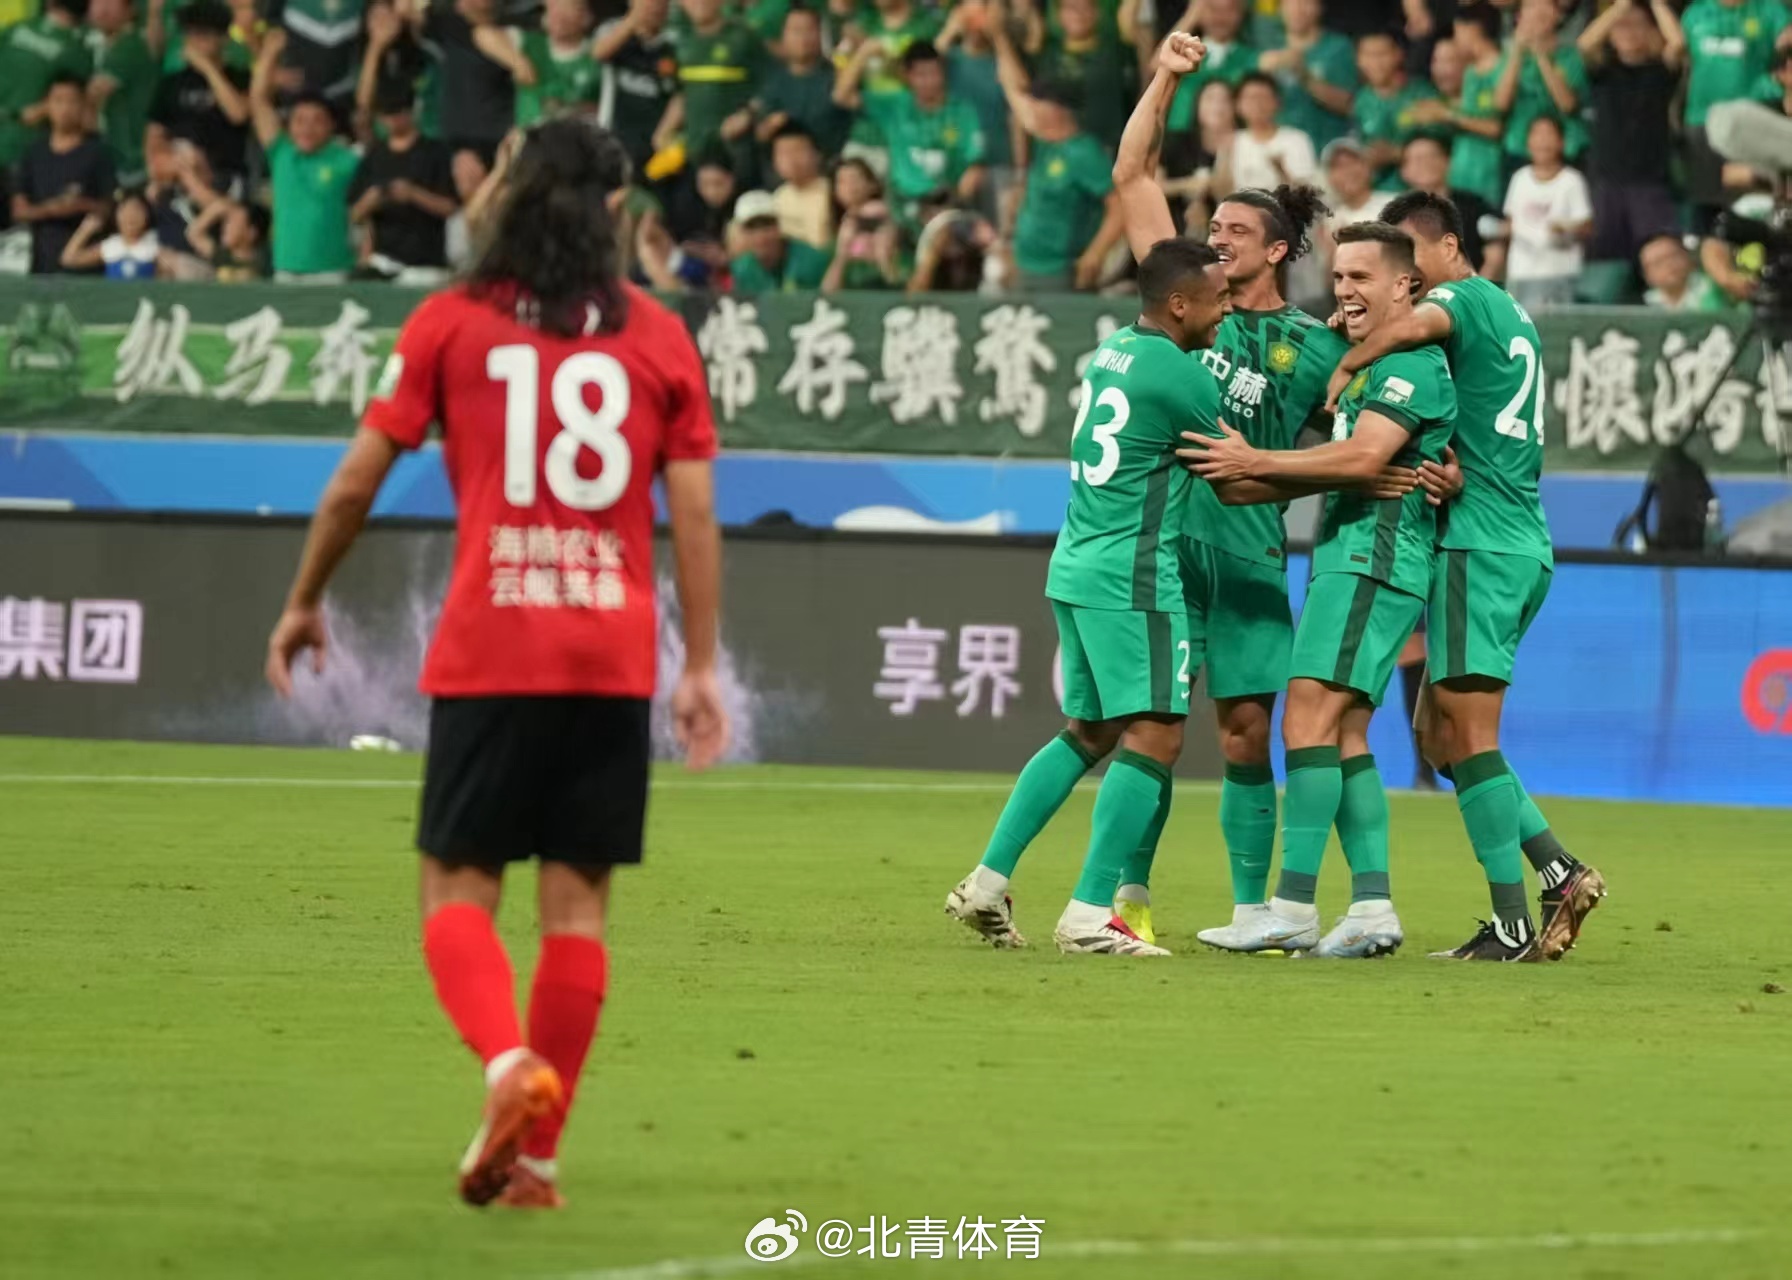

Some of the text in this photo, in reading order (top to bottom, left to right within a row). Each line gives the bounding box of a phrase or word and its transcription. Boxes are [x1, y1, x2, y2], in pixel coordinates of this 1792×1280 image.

[486, 343, 632, 511] 18
[1201, 349, 1268, 405] 中赫
[1070, 378, 1130, 486] 23
[0, 596, 143, 683] 集团
[873, 617, 1022, 718] 享界
